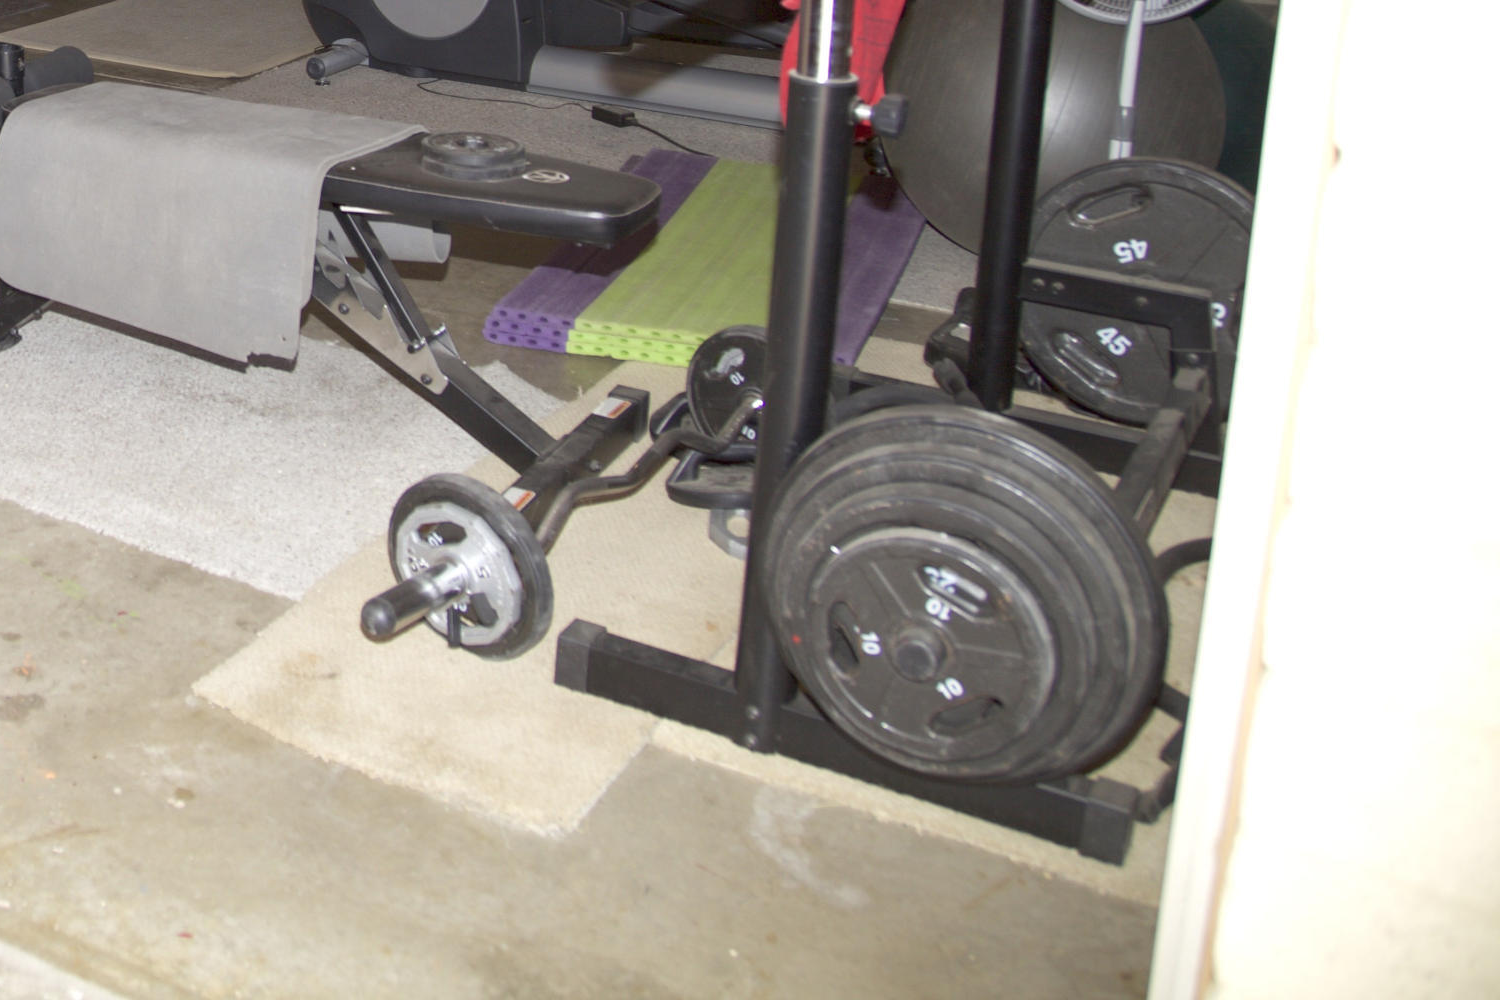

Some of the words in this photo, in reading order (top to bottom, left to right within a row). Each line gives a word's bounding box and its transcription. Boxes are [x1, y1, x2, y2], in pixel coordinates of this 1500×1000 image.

[1113, 239, 1148, 263] 45
[1097, 327, 1133, 356] 45
[730, 371, 745, 386] 10
[741, 425, 756, 440] 10
[925, 597, 951, 620] 10
[860, 631, 882, 656] 10
[936, 677, 964, 700] 10
